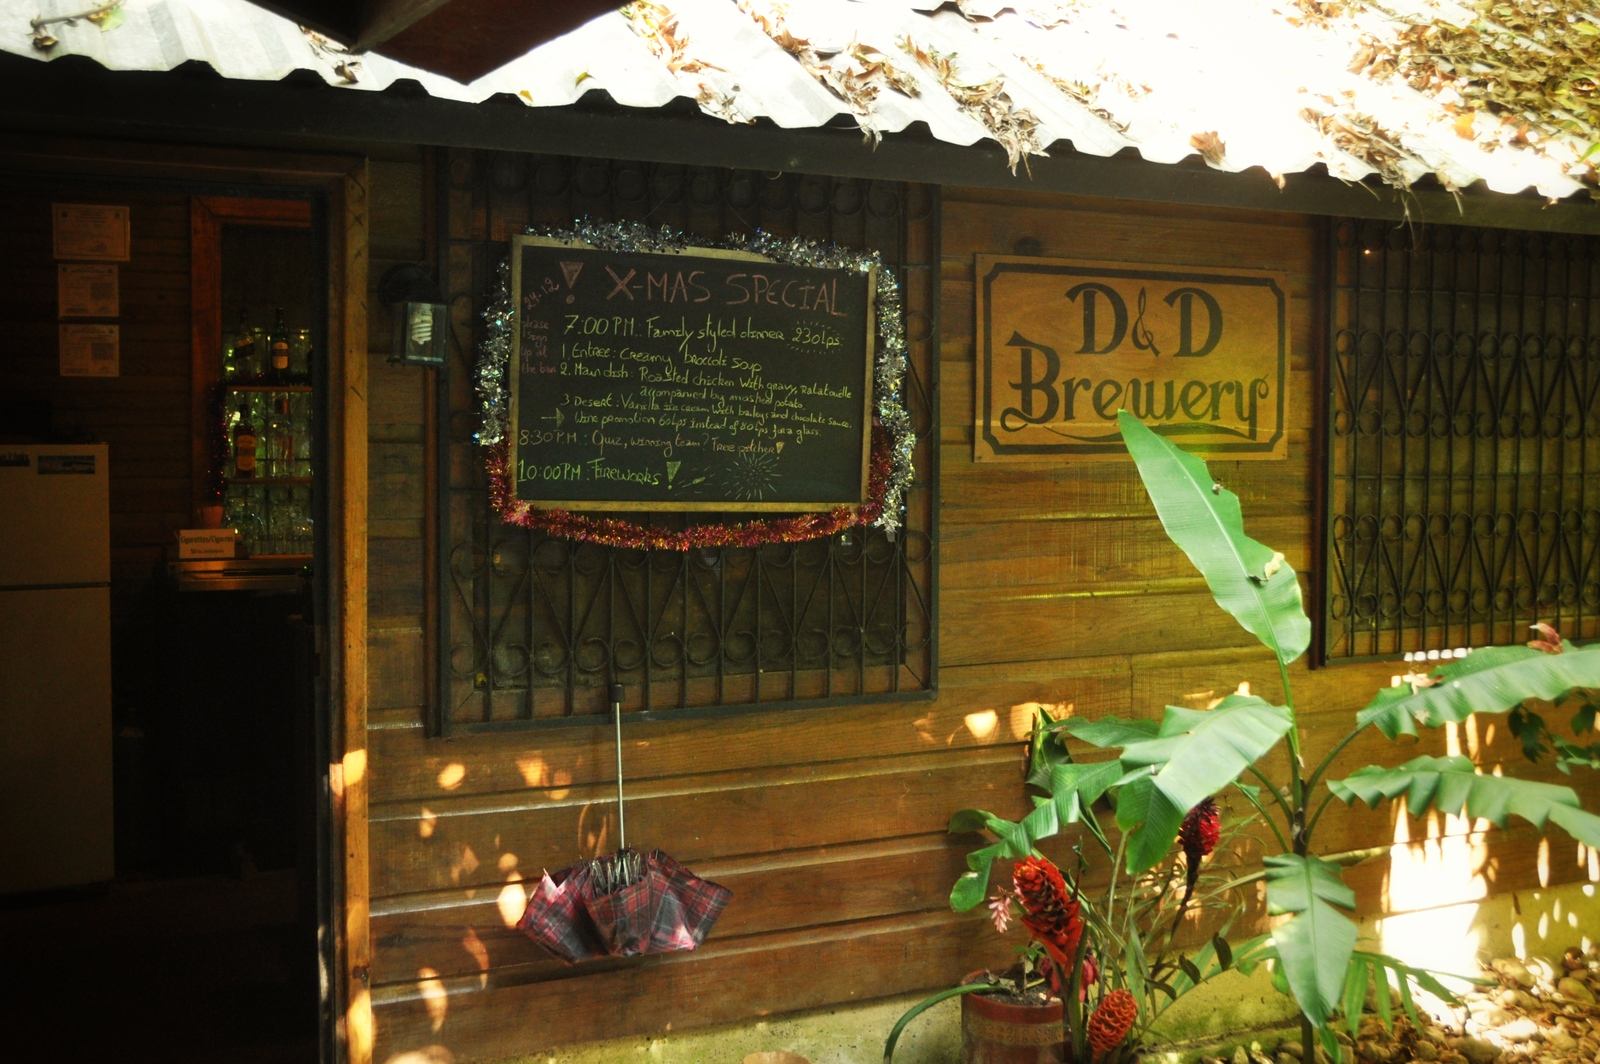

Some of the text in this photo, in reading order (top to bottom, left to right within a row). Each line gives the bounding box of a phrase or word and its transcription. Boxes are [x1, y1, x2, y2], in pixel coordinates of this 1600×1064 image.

[604, 264, 711, 303] X-MAS
[726, 273, 848, 317] SPECIAL
[646, 315, 694, 353] Family
[697, 313, 736, 353] styled
[575, 363, 601, 377] Main
[640, 366, 689, 384] Roasted
[1000, 330, 1269, 441] Brewery
[711, 388, 725, 409] by
[729, 419, 739, 436] of
[791, 411, 825, 424] chocolate
